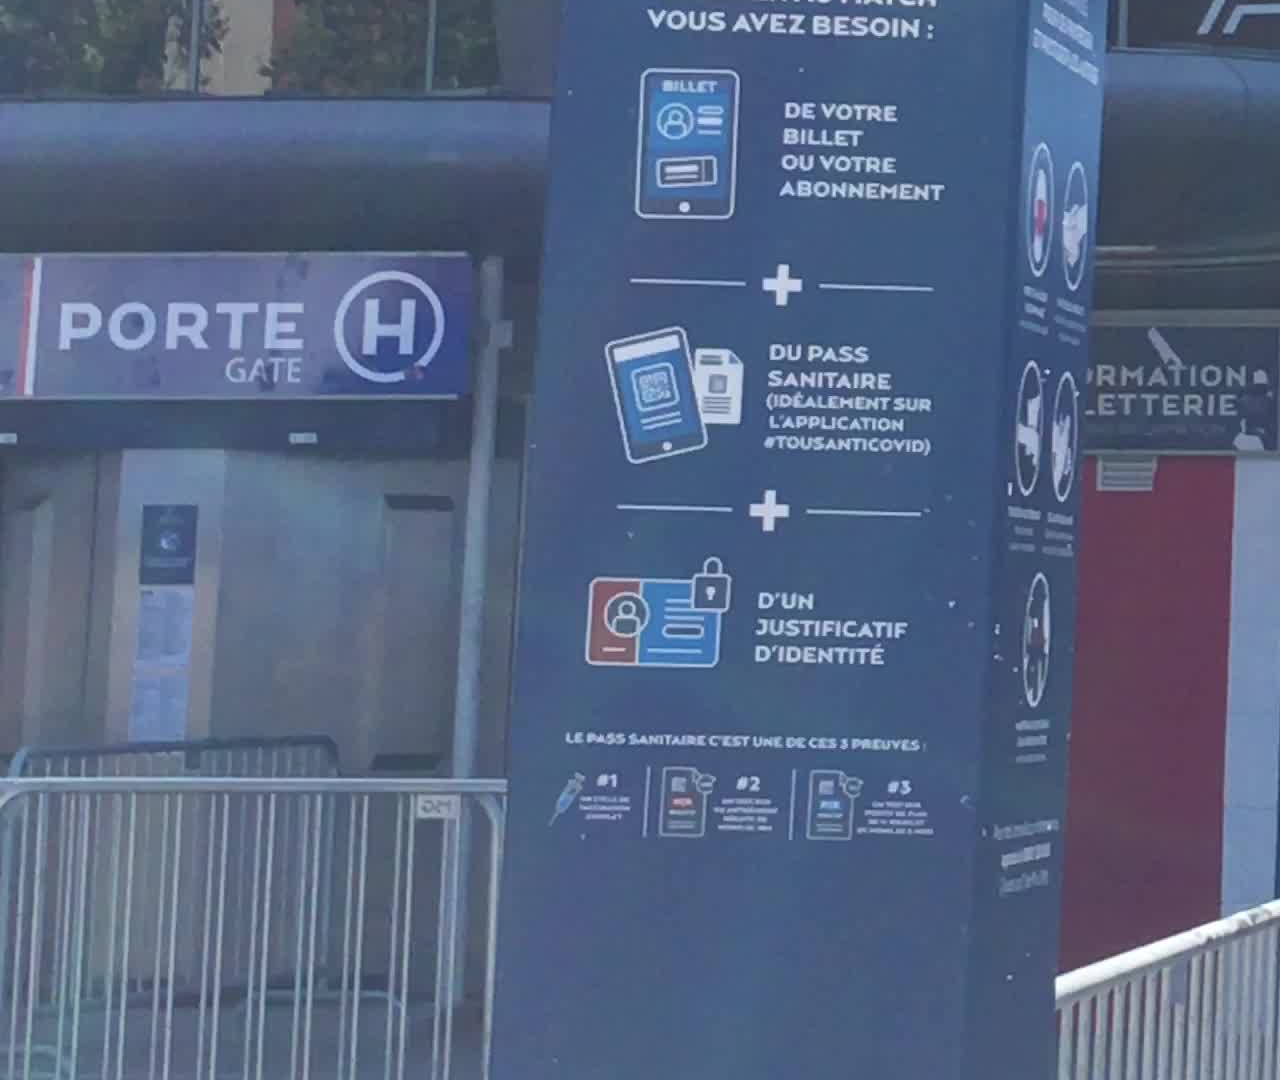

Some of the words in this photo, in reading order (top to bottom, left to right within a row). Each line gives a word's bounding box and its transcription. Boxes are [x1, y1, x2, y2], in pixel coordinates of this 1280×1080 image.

[648, 9, 726, 31] VOUS
[733, 13, 805, 34] AVEZ
[662, 80, 718, 94] BILLET
[785, 102, 815, 120] DE
[822, 104, 897, 122] VOTRE
[783, 128, 863, 147] BILLET
[782, 154, 818, 172] OU
[821, 156, 896, 173] VOTRE
[780, 180, 945, 201] ABONNEMENT
[58, 301, 304, 351] PORTE
[361, 298, 415, 356] H
[769, 344, 801, 361] DU
[808, 345, 869, 363] PASS
[225, 357, 302, 383] GATE
[1087, 365, 1247, 387] RMATION
[768, 371, 891, 390] SANITAIRE
[893, 398, 932, 412] SUR
[769, 415, 904, 432] L'APPLICATION
[758, 592, 814, 611] D'UN
[755, 618, 908, 639] JUSTIFICATIF
[565, 732, 584, 744] LE
[587, 732, 626, 745] PASS
[628, 733, 706, 747] SANITAIRE
[752, 736, 784, 749] UNE
[785, 737, 807, 749] DE
[808, 737, 837, 750] CES
[851, 738, 920, 751] PREUVES
[736, 776, 761, 792] #2
